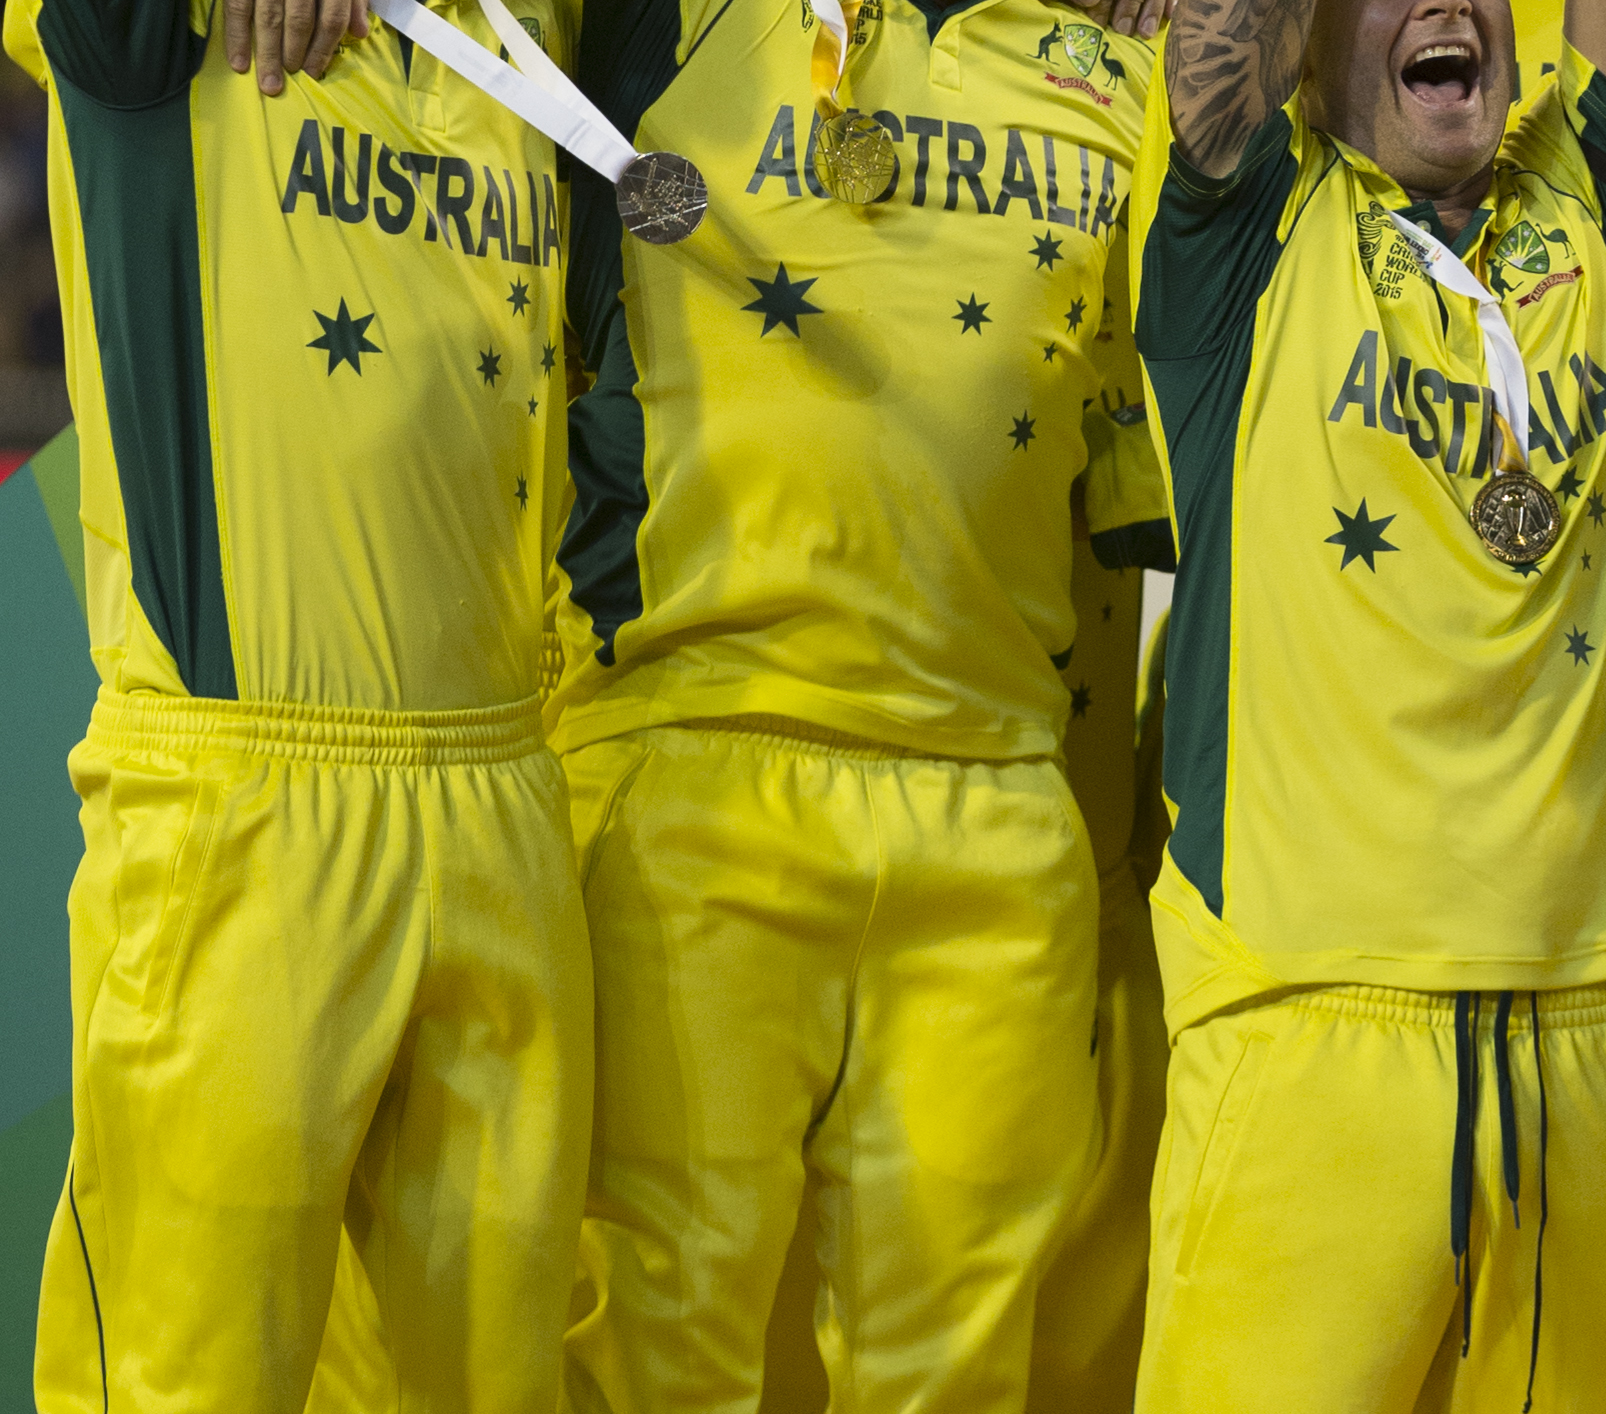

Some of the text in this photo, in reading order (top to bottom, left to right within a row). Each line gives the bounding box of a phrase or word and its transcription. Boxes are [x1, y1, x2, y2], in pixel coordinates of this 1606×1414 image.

[281, 118, 562, 271] AUSTRALIA
[1379, 268, 1406, 286] CUP
[1373, 282, 1404, 301] 2015
